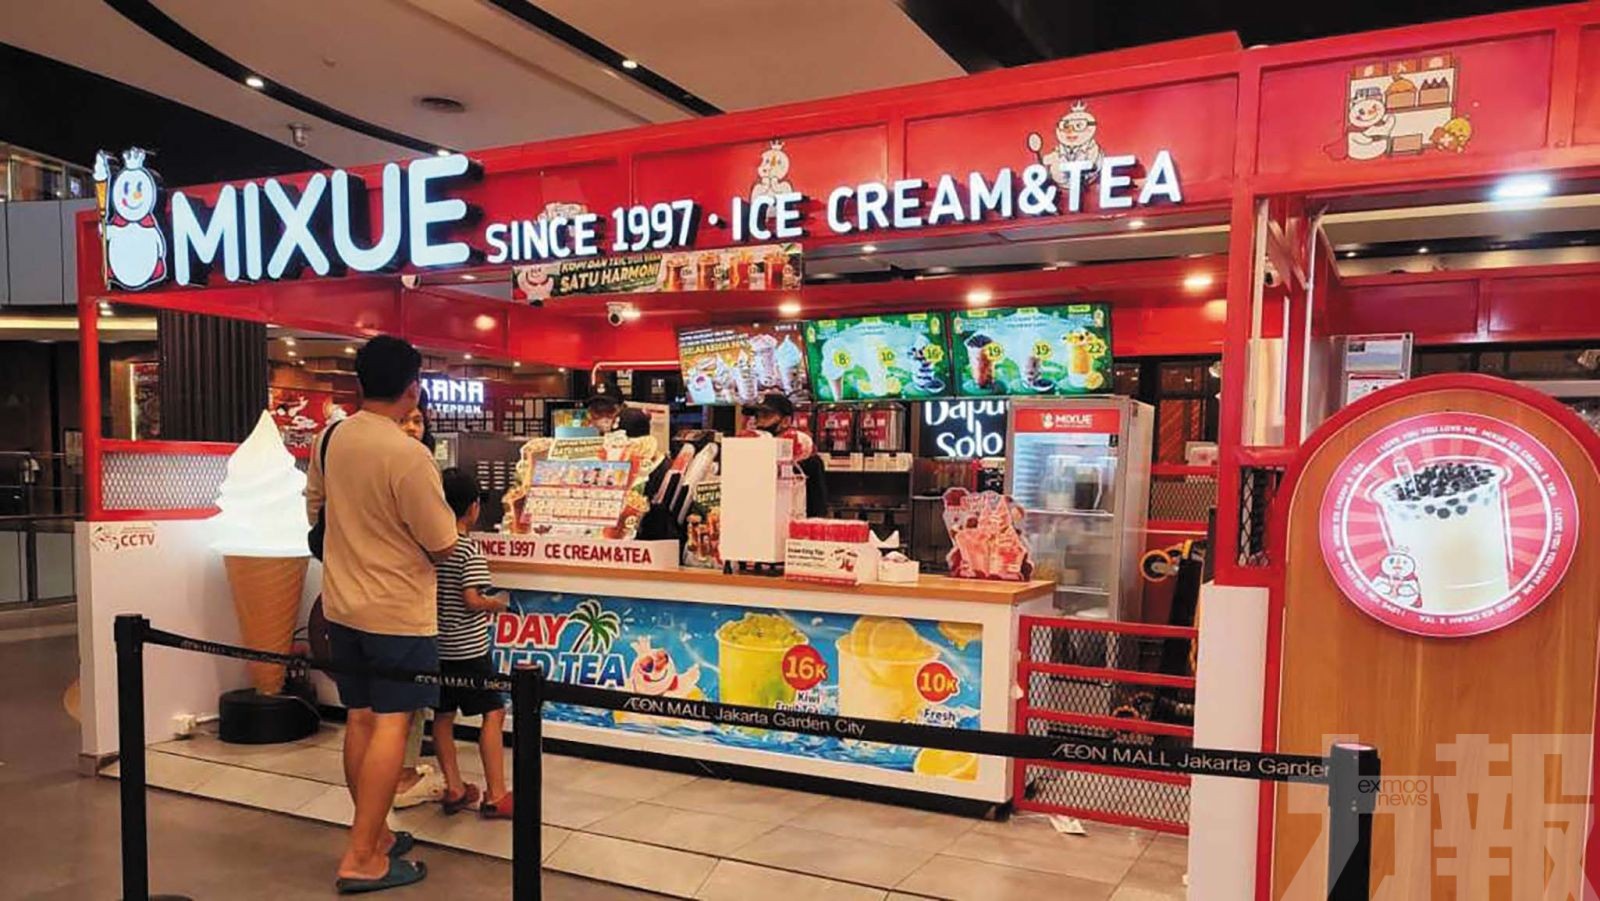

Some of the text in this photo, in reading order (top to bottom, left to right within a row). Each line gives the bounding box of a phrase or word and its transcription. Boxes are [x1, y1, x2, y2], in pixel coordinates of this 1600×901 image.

[485, 213, 598, 263] SINCE
[612, 199, 694, 251] 1997
[732, 192, 803, 240] ICE
[827, 150, 1182, 233] CREAM&TEA
[172, 154, 470, 286] MIXUE
[560, 270, 599, 293] SATU
[601, 263, 660, 285] HARMONI
[988, 345, 1001, 357] 19
[1036, 344, 1051, 356] 19
[1088, 343, 1102, 355] 22
[925, 400, 1010, 433] Dapu
[1055, 414, 1093, 425] MIXUE
[936, 420, 1003, 457] Solo
[120, 533, 155, 547] CCTV
[477, 540, 506, 557] INCE
[509, 540, 536, 558] 1997
[564, 544, 652, 564] CREAM&TEA
[495, 613, 568, 648] DAY
[560, 652, 627, 690] TEA
[785, 655, 827, 681] 16K
[920, 672, 957, 694] 10K
[797, 691, 821, 702] Kiwi
[667, 701, 711, 720] MALL
[714, 706, 768, 725] Jakarta
[773, 712, 830, 732] Garden
[835, 717, 865, 737] City
[923, 708, 956, 721] Fresh
[1113, 747, 1171, 767] MALL
[1177, 753, 1251, 772] Jakarta
